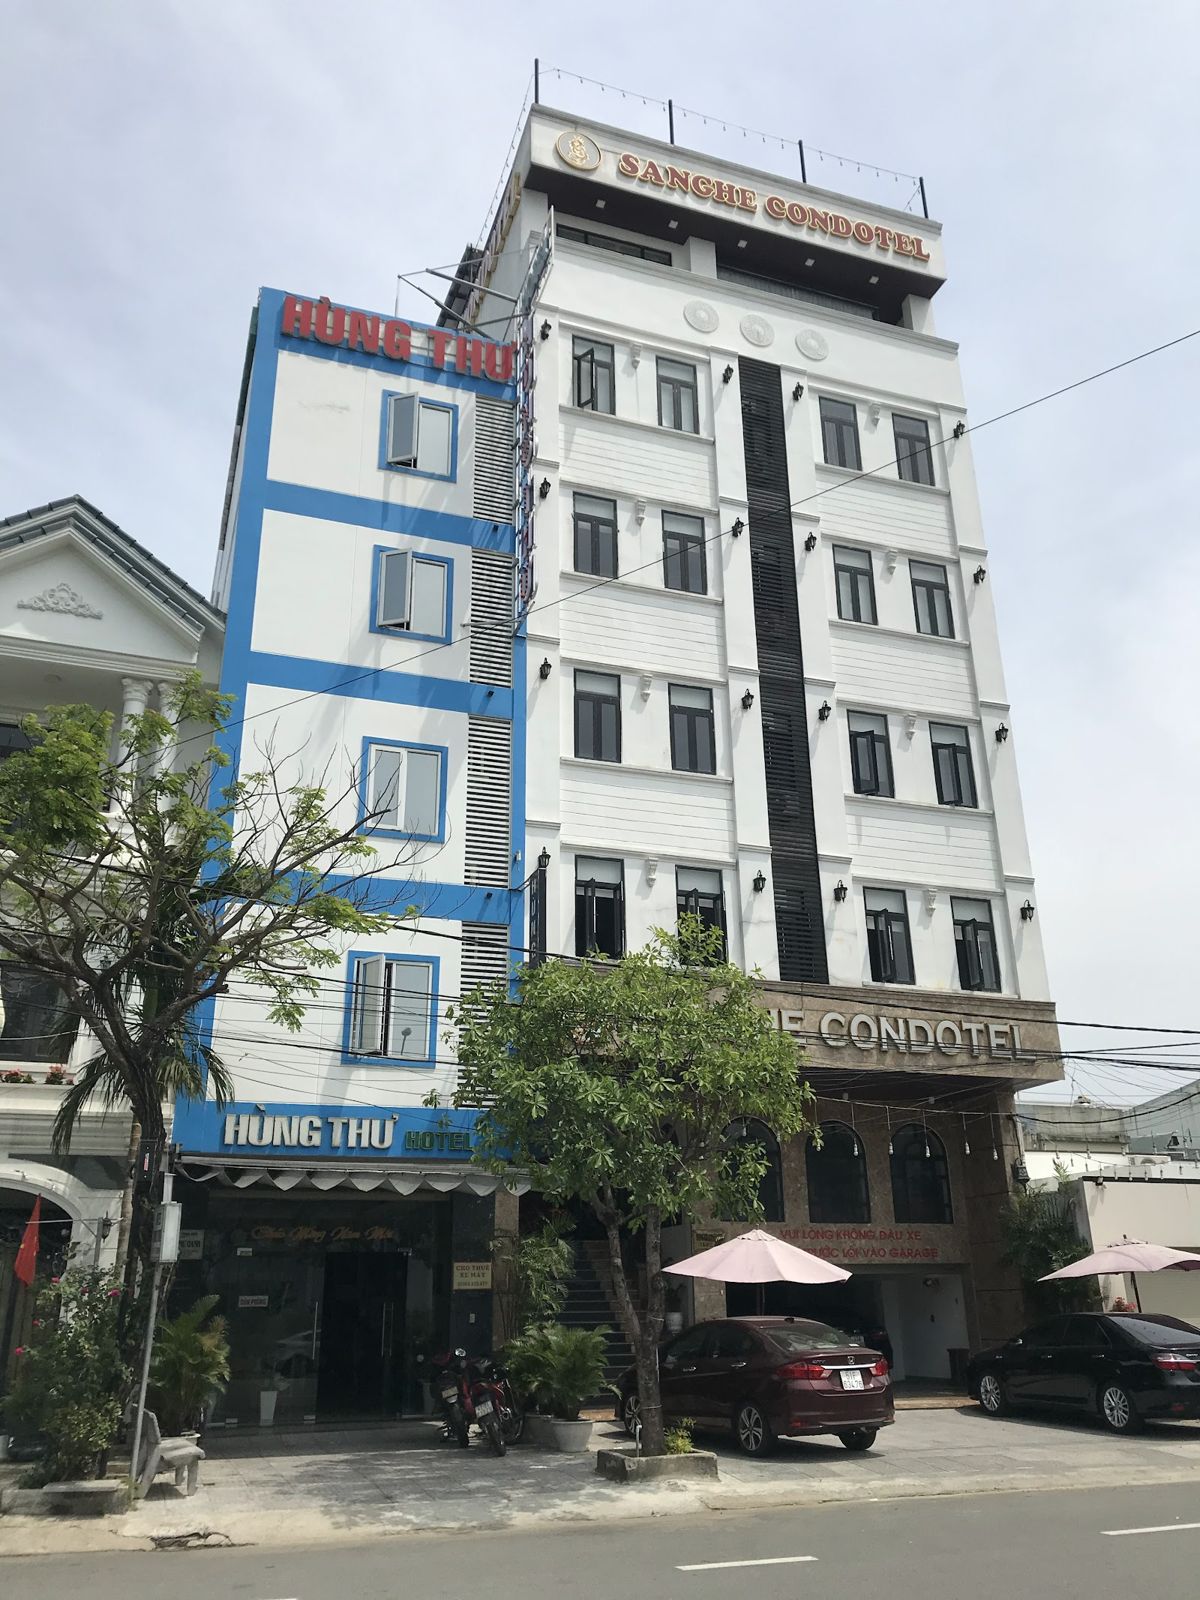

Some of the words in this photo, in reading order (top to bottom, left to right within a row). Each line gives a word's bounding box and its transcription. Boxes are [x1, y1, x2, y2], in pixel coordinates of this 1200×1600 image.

[618, 152, 758, 212] SANGHE
[764, 194, 931, 262] CONDOTEL
[282, 295, 412, 362] HÙNG
[427, 330, 518, 382] THƯ
[820, 1012, 1037, 1061] CONDOTEL
[224, 1104, 323, 1147] HÙNG
[327, 1114, 400, 1149] THƯ
[405, 1130, 473, 1151] HOTEL
[780, 1230, 798, 1241] VUI
[836, 1228, 876, 1241] KHÔNG
[907, 1230, 922, 1241] XE
[863, 1246, 887, 1258] VÀO
[889, 1247, 939, 1259] GARAGE
